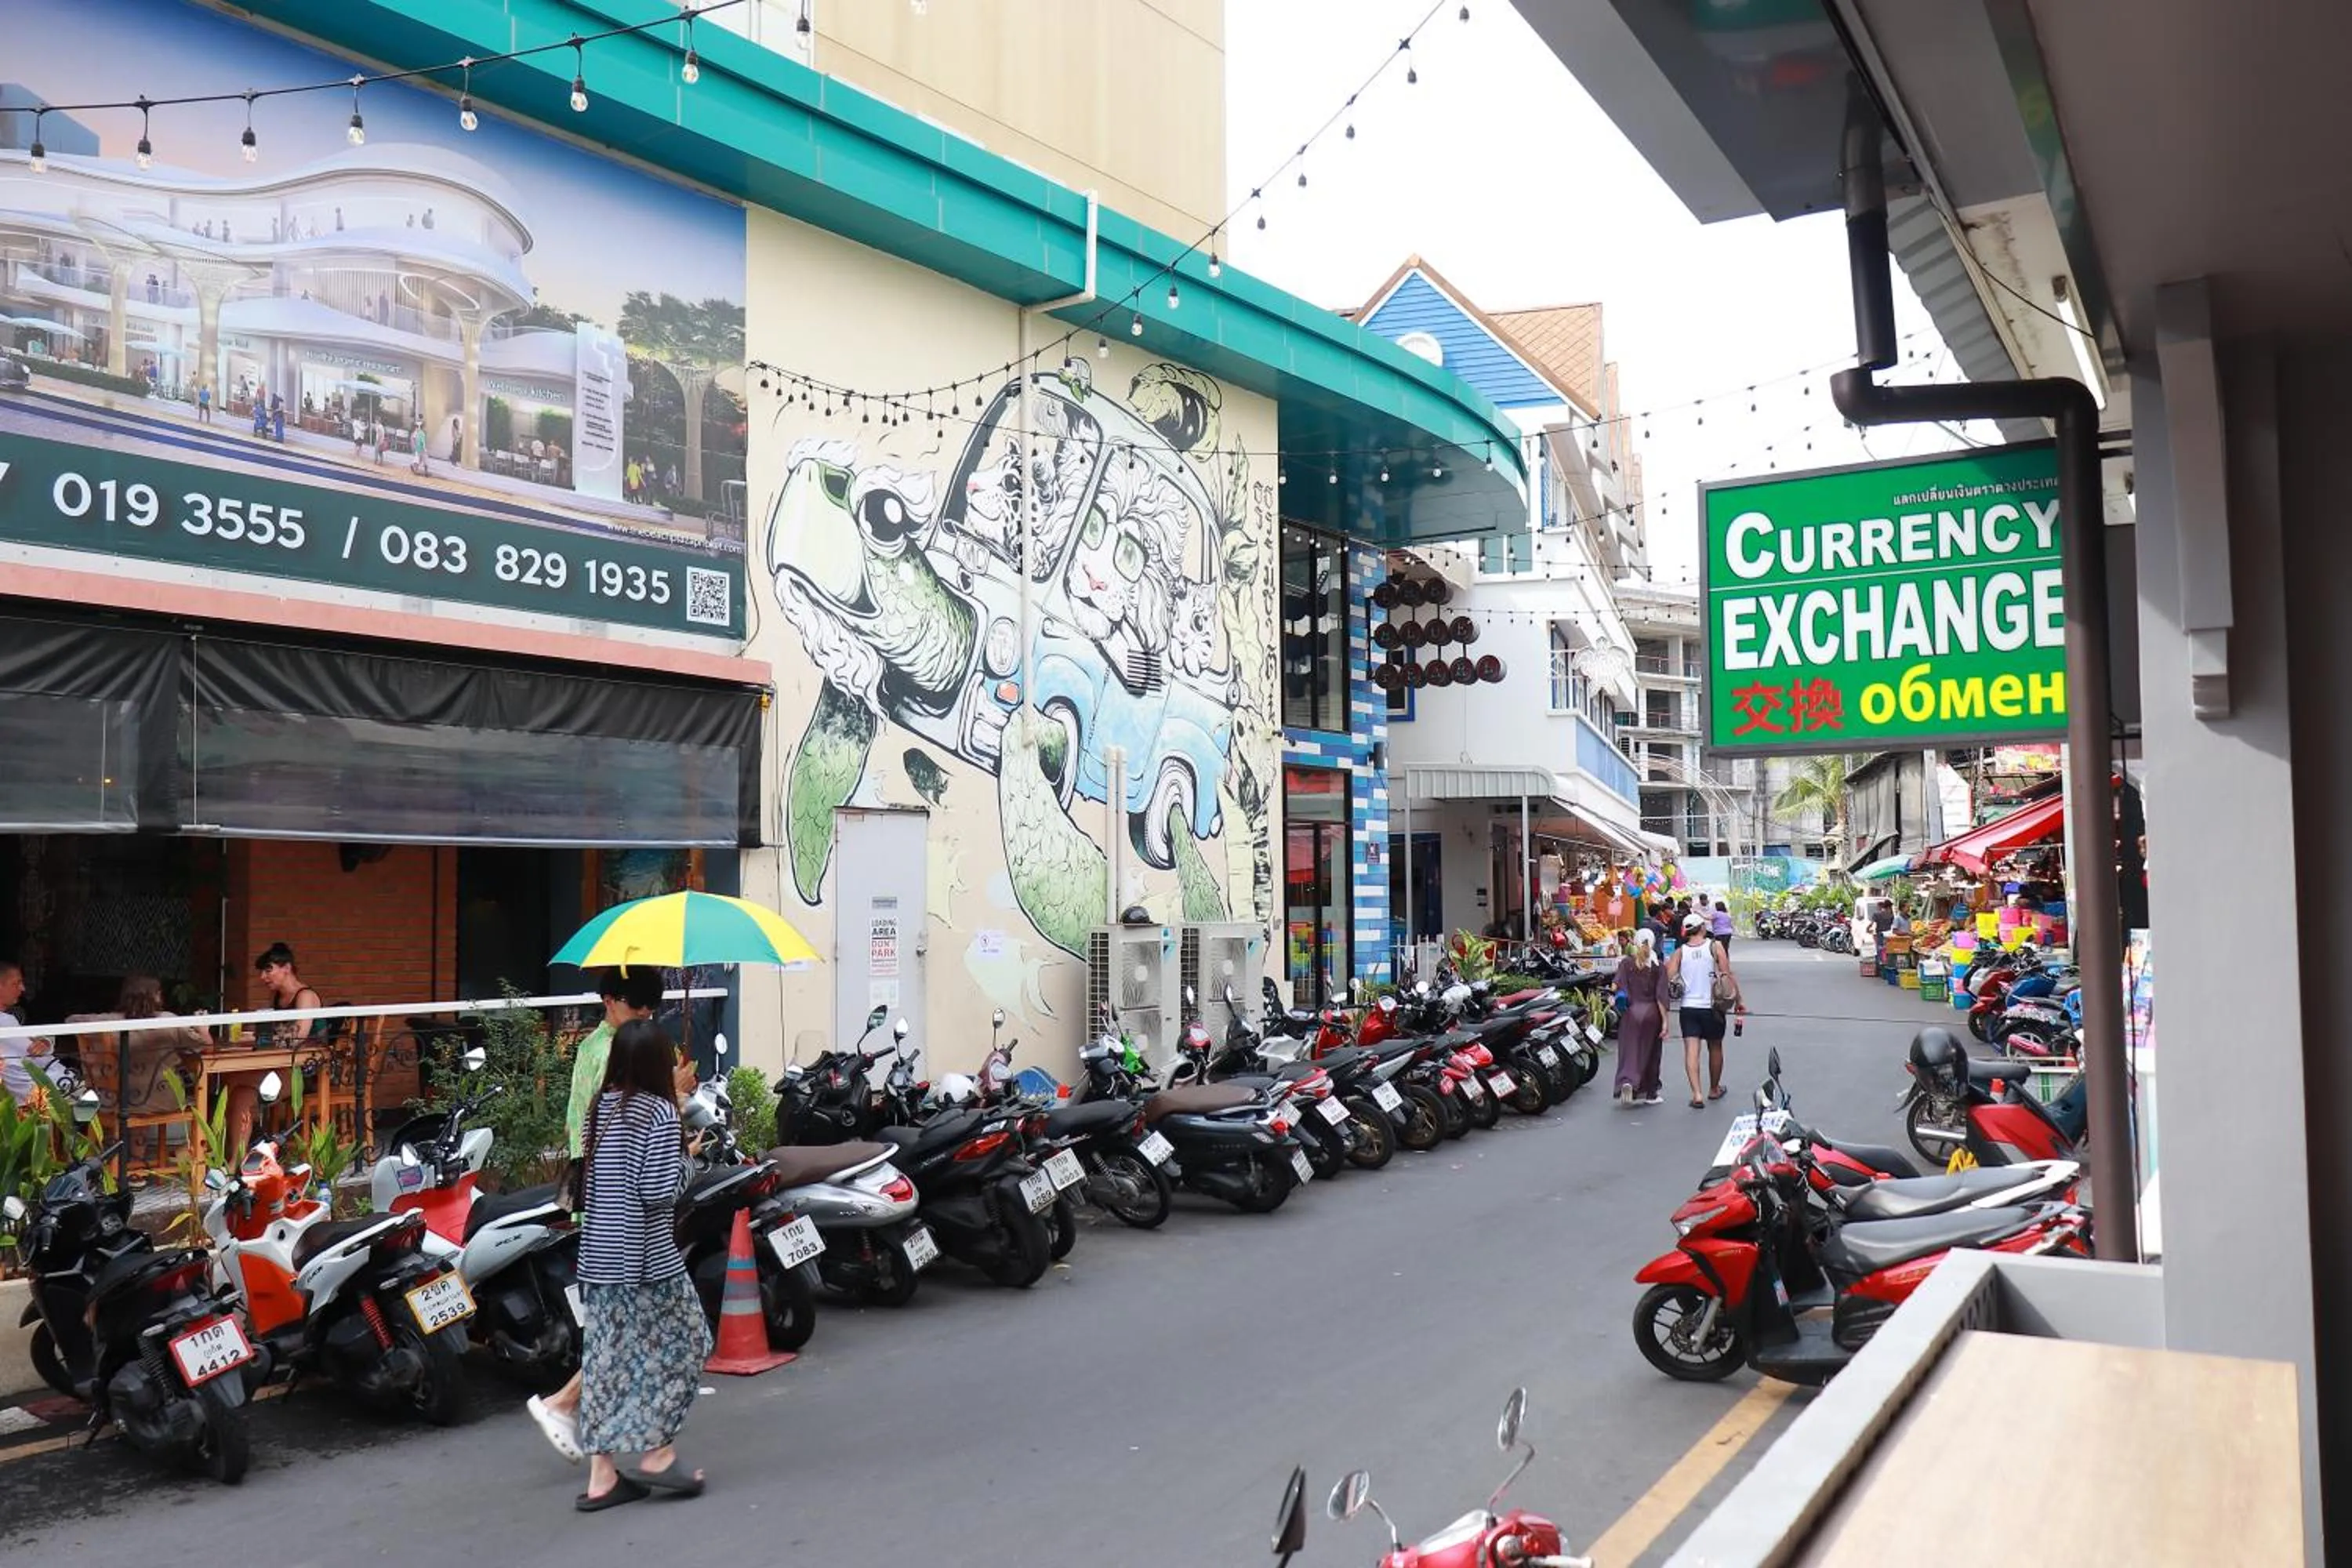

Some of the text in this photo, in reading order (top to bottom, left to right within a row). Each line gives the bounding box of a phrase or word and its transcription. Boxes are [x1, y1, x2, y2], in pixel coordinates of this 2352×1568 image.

[53, 473, 159, 526] 019
[181, 492, 305, 549] 3555
[380, 525, 467, 573] 083
[495, 544, 567, 589] 829
[585, 559, 670, 604] 1935
[1726, 500, 2060, 579] CURRENCY
[1723, 568, 2066, 670] EXCHANGE
[1733, 678, 1843, 735] 交換
[1860, 664, 2064, 724] обмен
[871, 927, 896, 936] AREA
[871, 949, 896, 957] PARK
[787, 1242, 818, 1263] 7083
[430, 1301, 466, 1327] 2539
[198, 1349, 240, 1377] 4412
